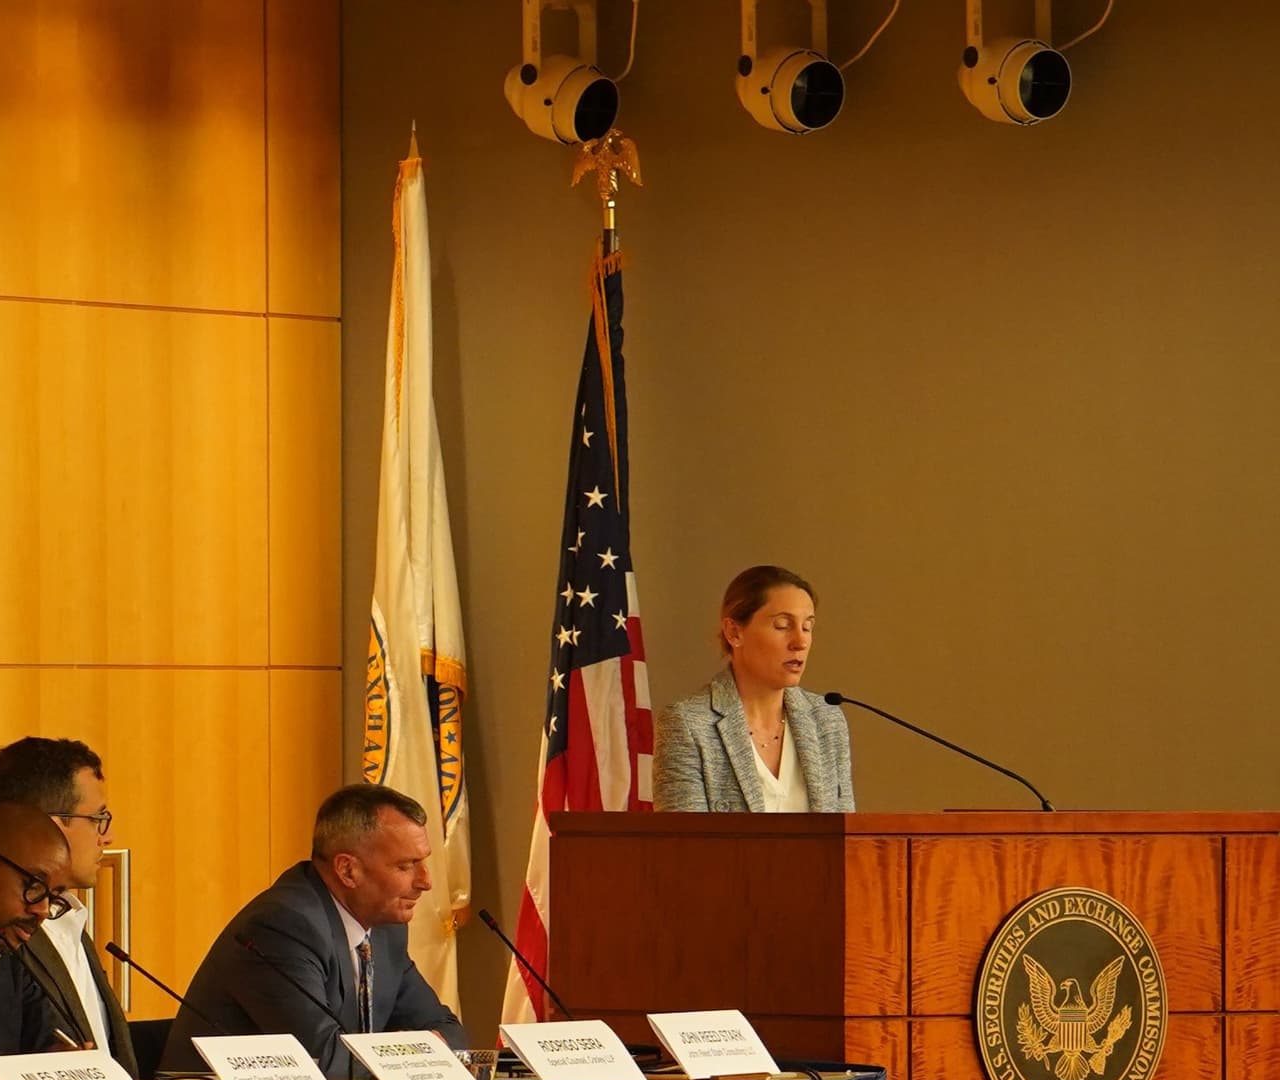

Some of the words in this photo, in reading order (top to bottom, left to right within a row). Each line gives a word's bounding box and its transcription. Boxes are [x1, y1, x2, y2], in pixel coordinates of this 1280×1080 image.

[985, 924, 1026, 1046] SECURITIES
[1028, 900, 1061, 932] AND
[1063, 896, 1144, 954] EXCHANGE
[698, 1030, 721, 1042] REED
[538, 1039, 579, 1051] RODRIGO
[226, 1056, 260, 1070] SARAH
